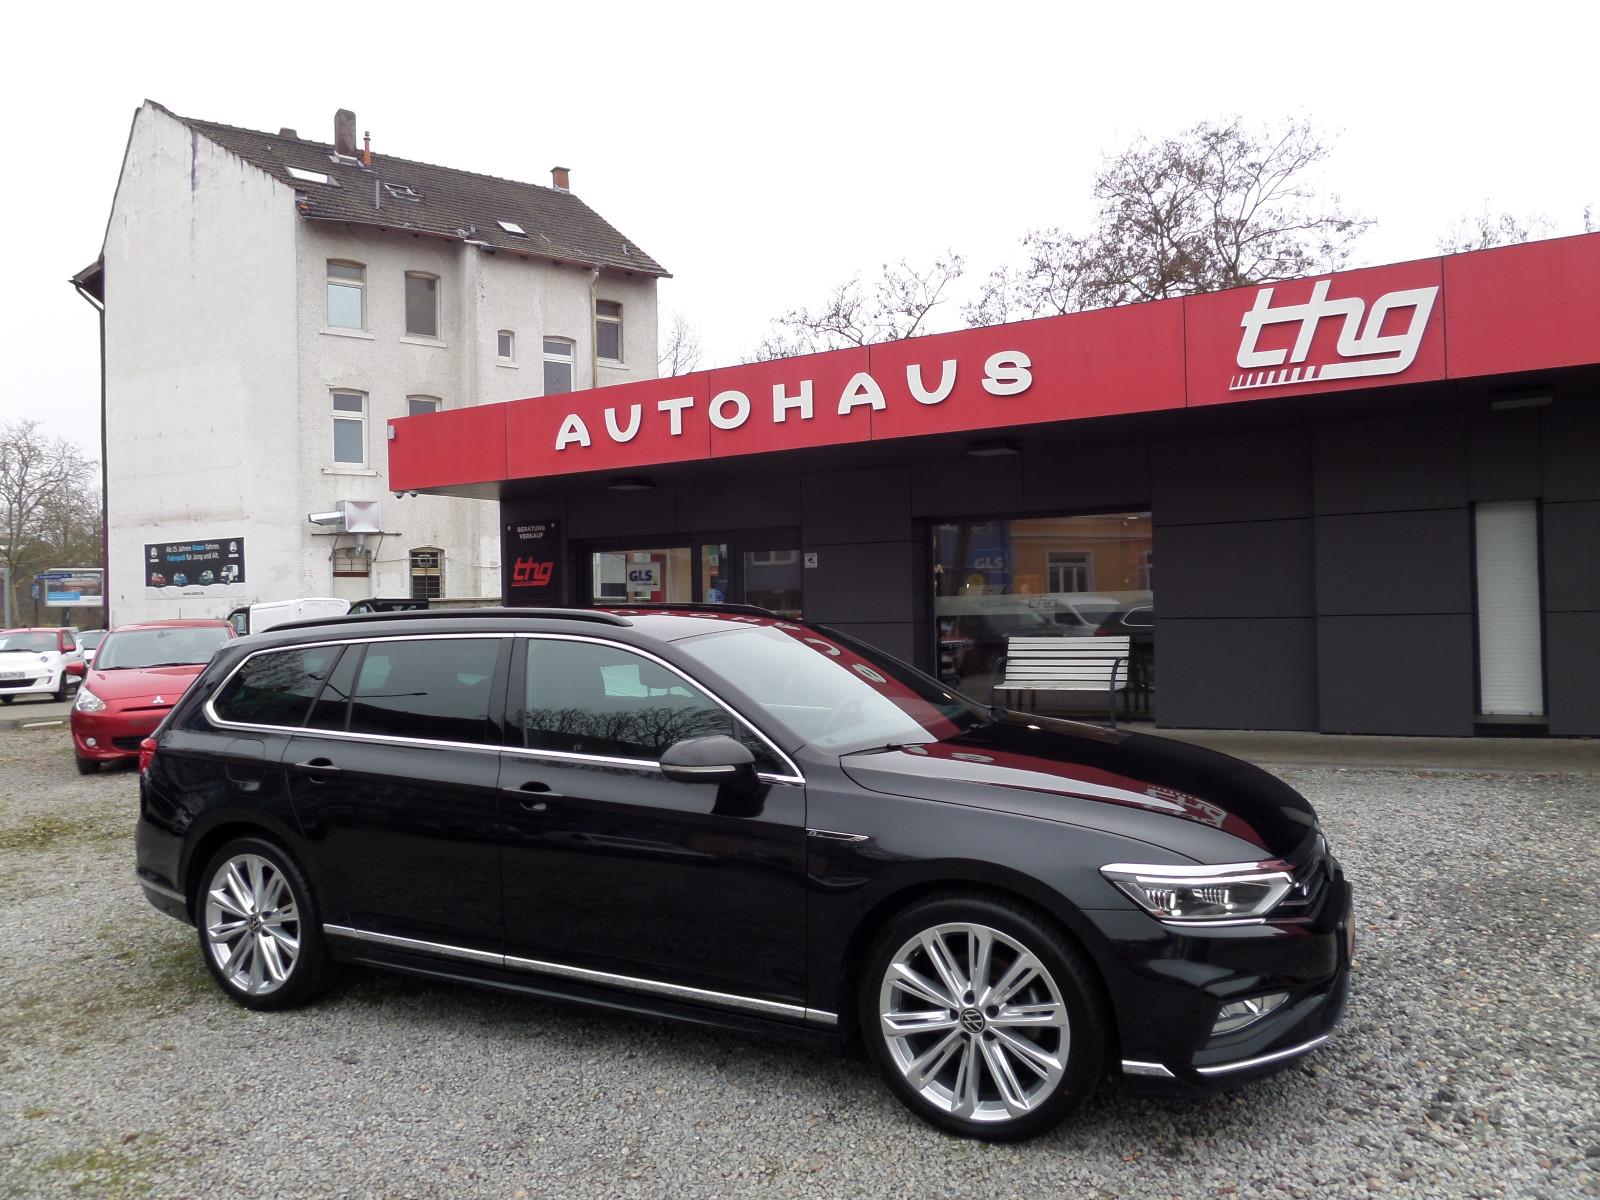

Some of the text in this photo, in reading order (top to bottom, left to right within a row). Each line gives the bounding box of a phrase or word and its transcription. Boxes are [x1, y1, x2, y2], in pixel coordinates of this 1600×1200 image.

[1229, 279, 1439, 391] thg
[555, 350, 1033, 450] AUTOHAUS
[517, 525, 546, 533] BERATUNG
[512, 556, 554, 587] thg
[975, 557, 1004, 569] GLS
[629, 570, 653, 582] GLS
